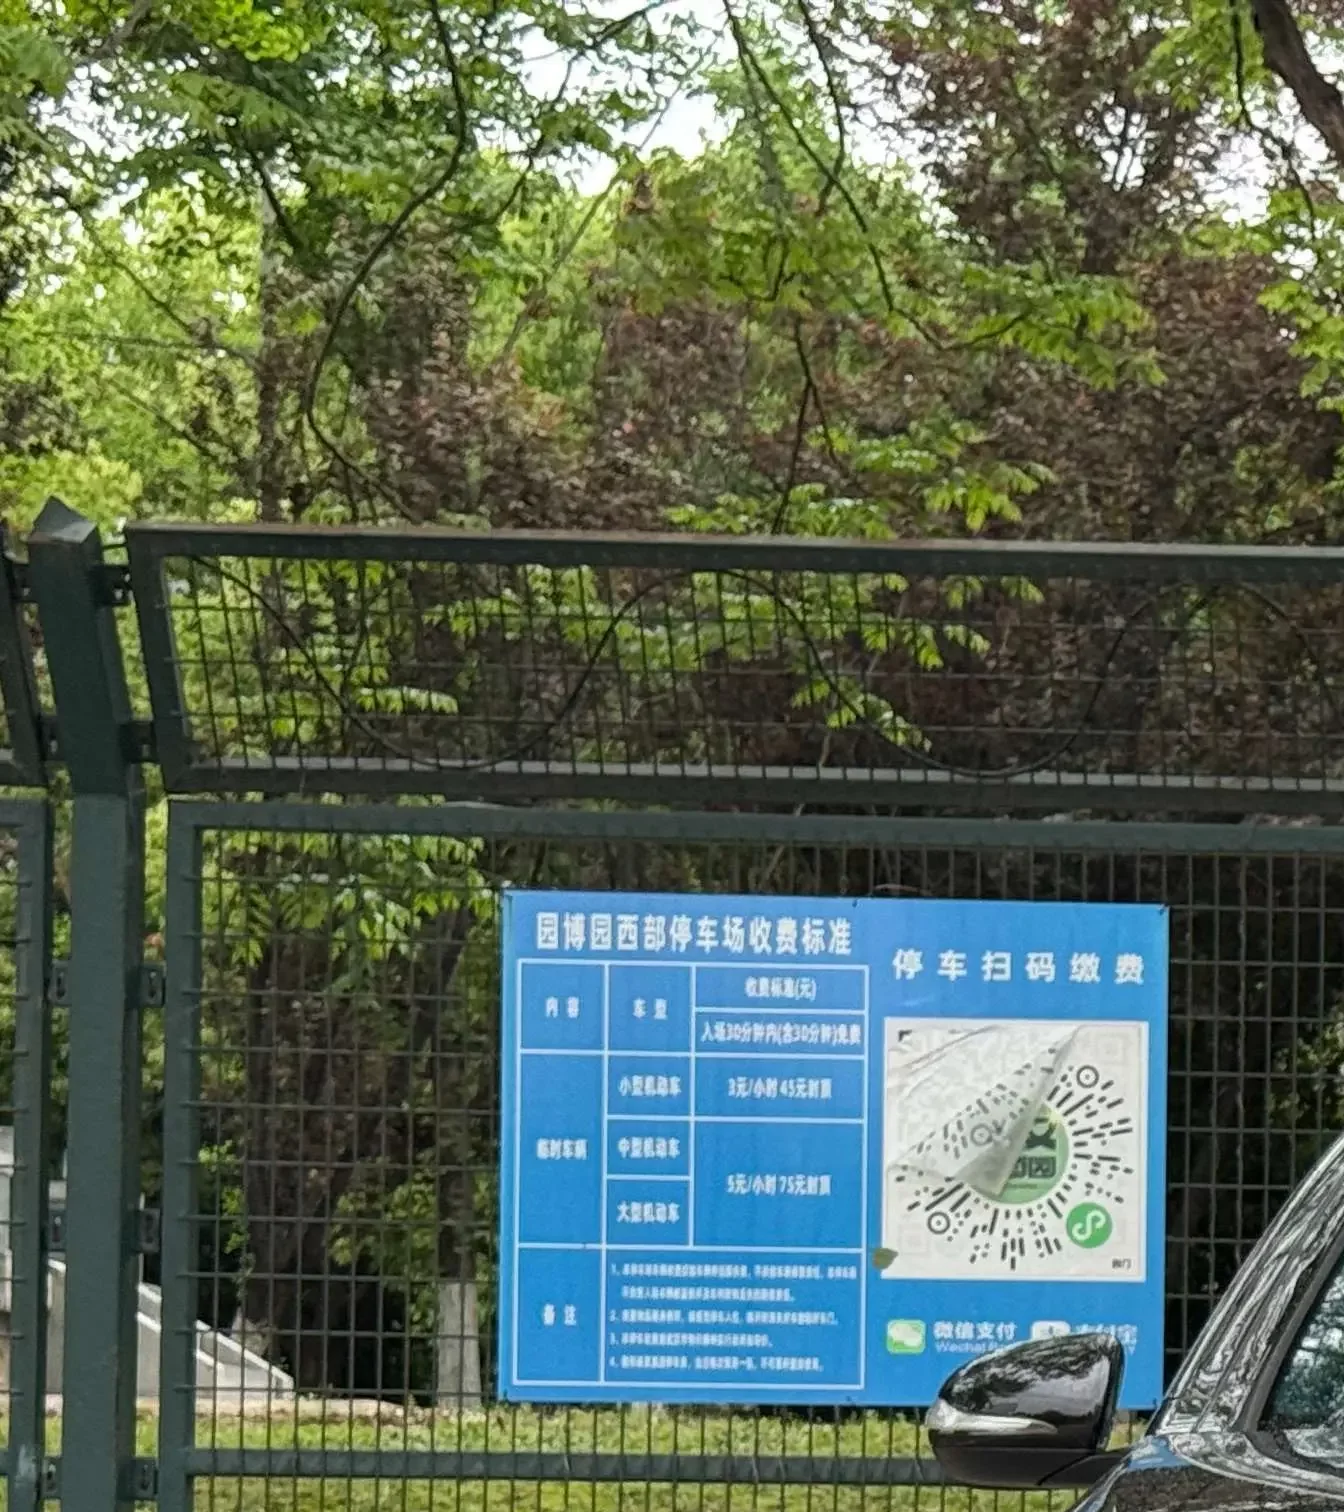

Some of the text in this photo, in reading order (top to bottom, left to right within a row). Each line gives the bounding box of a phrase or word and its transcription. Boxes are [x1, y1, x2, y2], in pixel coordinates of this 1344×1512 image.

[536, 911, 853, 955] 园博园西部停车场收费标准
[892, 949, 1145, 984] 停车扫码缴费
[618, 1075, 682, 1097] 小型机动车
[618, 1137, 681, 1159] 中型机动车
[616, 1202, 681, 1224] 大型机动车
[933, 1320, 1016, 1340] 微信支付
